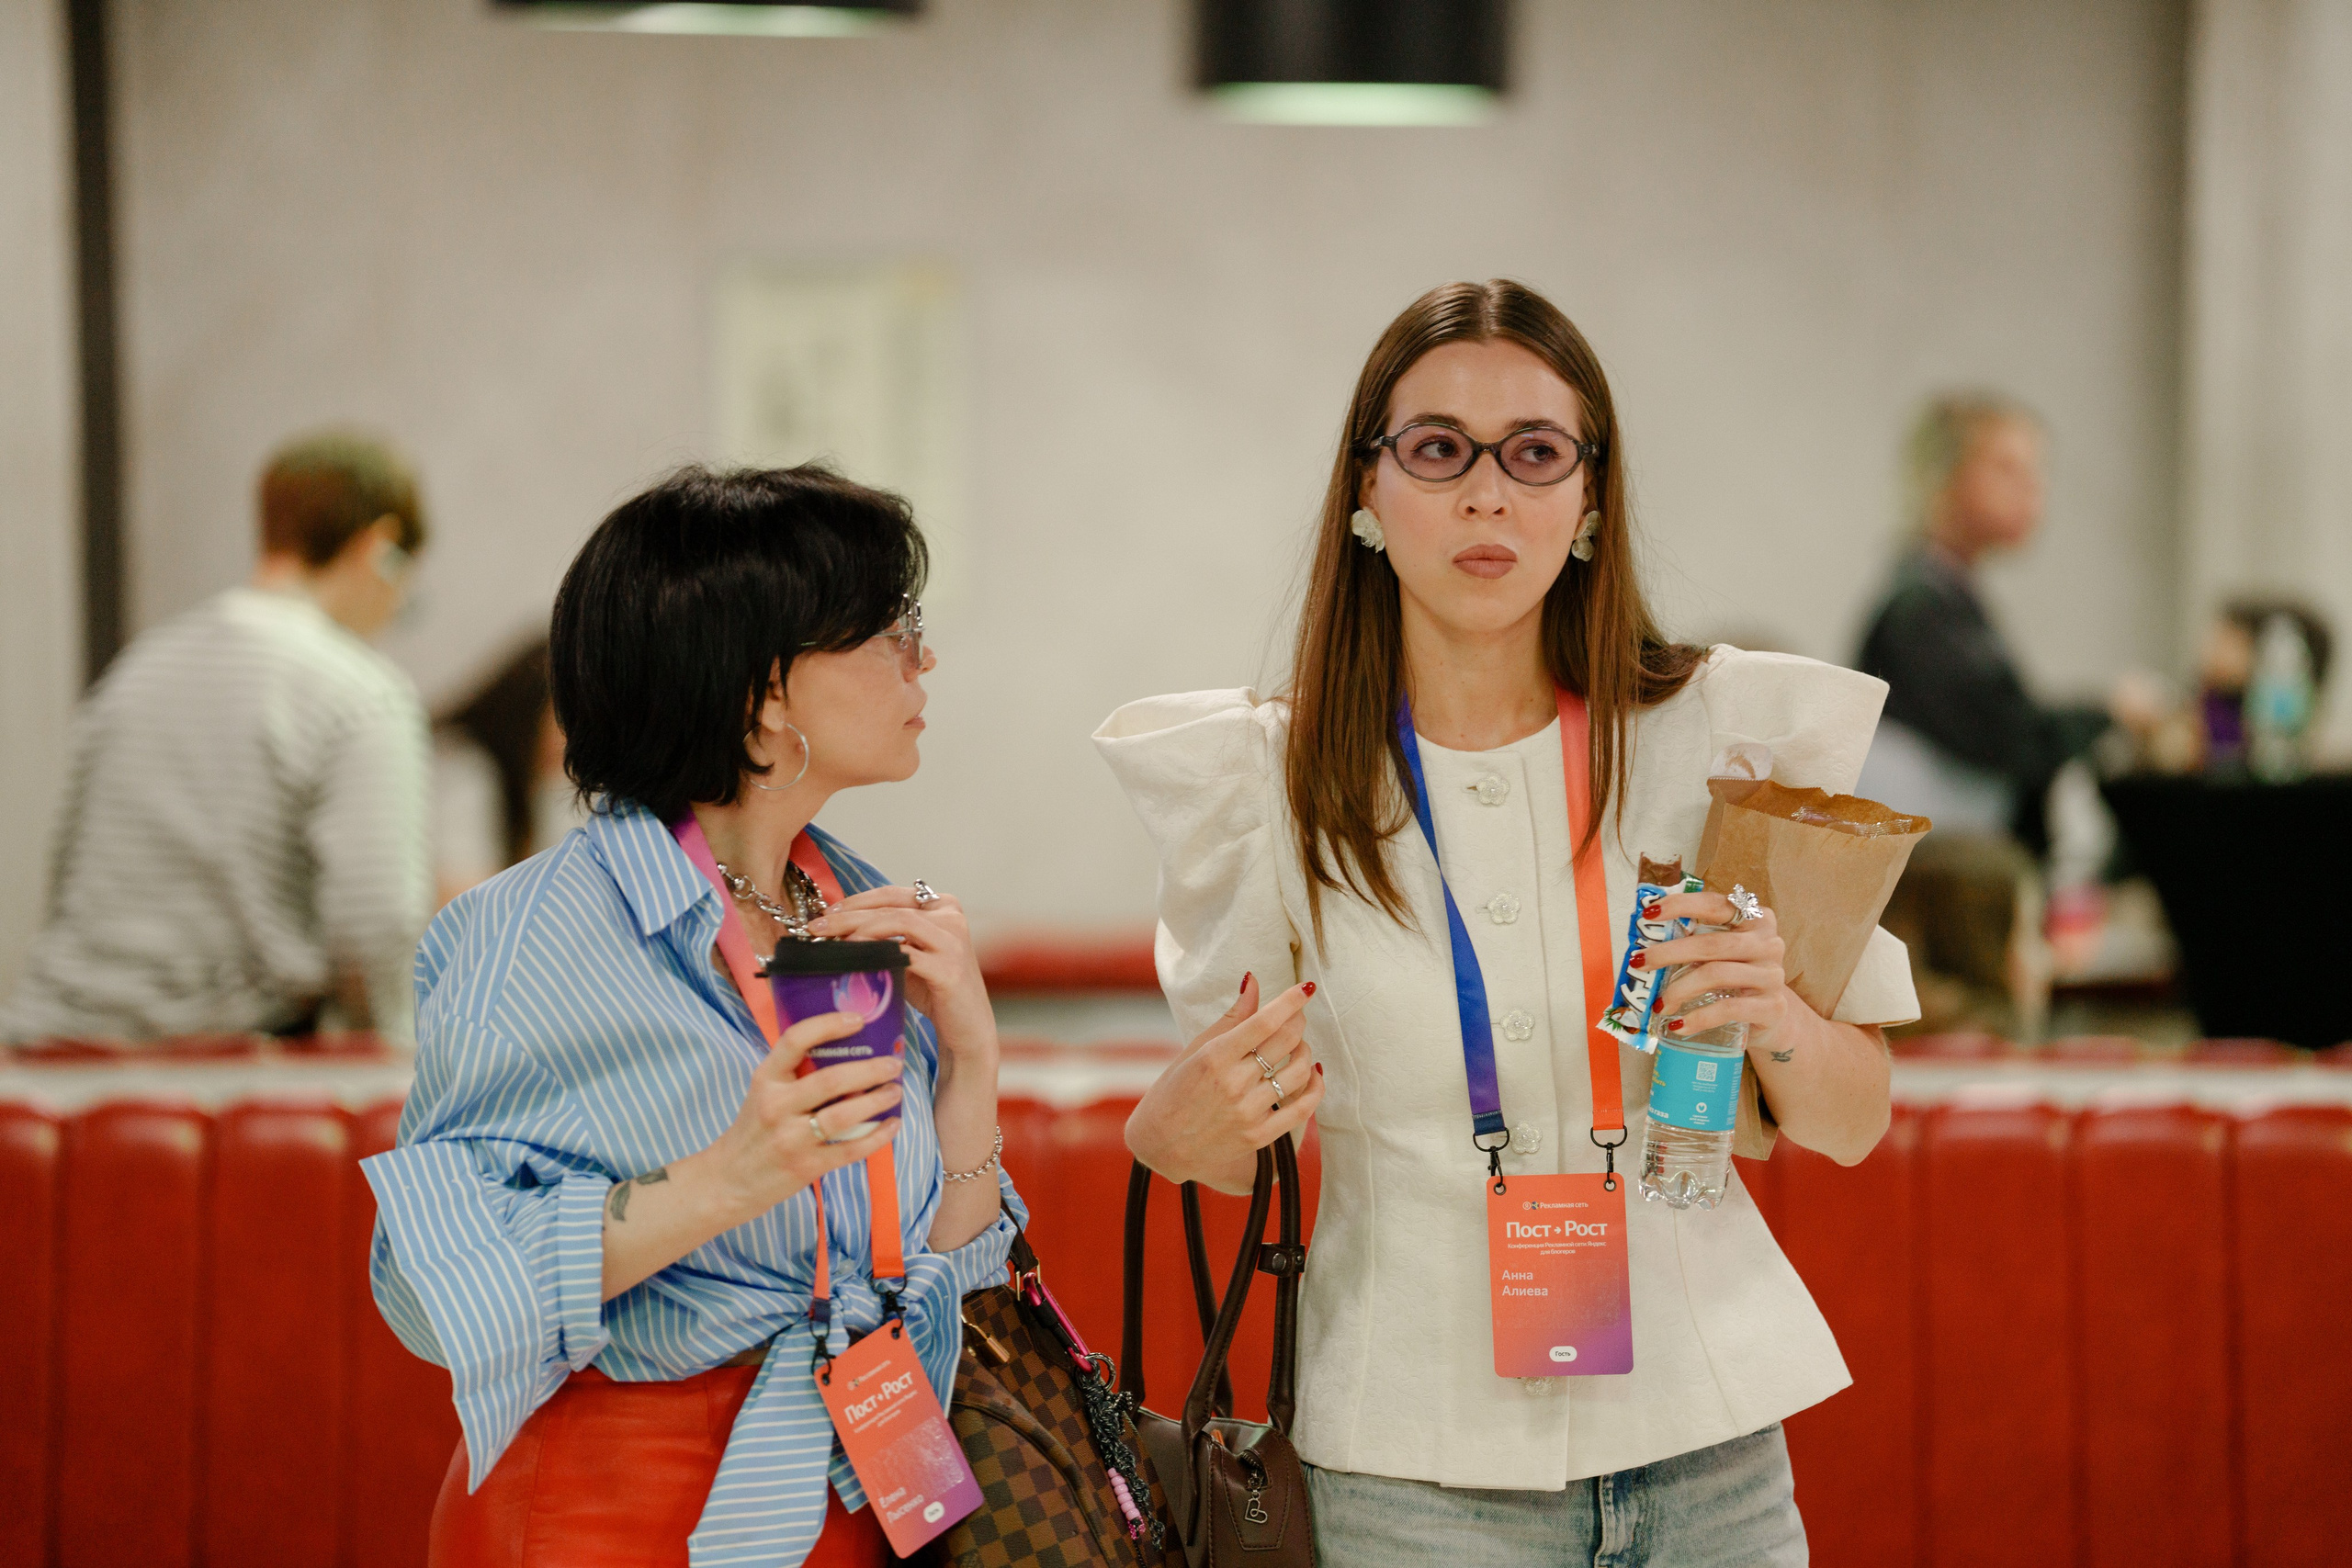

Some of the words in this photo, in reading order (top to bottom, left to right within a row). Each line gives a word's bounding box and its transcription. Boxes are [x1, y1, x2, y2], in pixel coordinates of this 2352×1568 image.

[1506, 1222, 1552, 1238] Пост
[1565, 1220, 1608, 1236] Рост
[1502, 1269, 1533, 1280] Анна
[1502, 1285, 1548, 1296] Алиева
[843, 1394, 878, 1425] Пост
[880, 1371, 913, 1400] Рост
